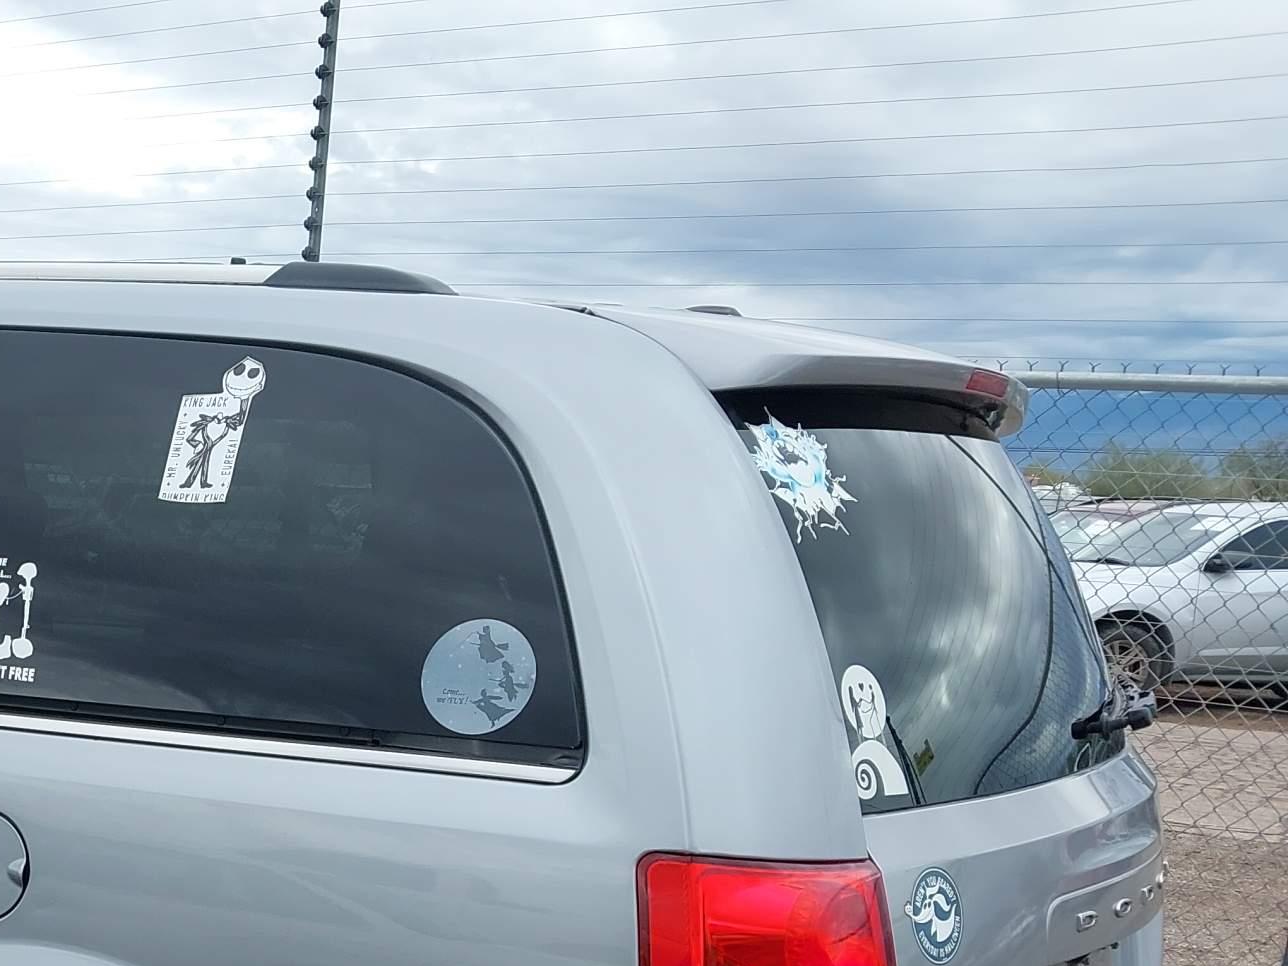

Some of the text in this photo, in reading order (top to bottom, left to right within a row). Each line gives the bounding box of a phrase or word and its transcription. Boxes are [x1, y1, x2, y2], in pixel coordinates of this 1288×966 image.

[183, 396, 228, 408] KING JACK
[166, 420, 189, 478] MR. UNLUCKY
[161, 492, 225, 502] PUMPKIN KING
[8, 666, 36, 682] FREE
[915, 876, 957, 908] AREN'T YOU SCARED?
[918, 915, 961, 957] EVERYDAY IS HALLOWEEN
